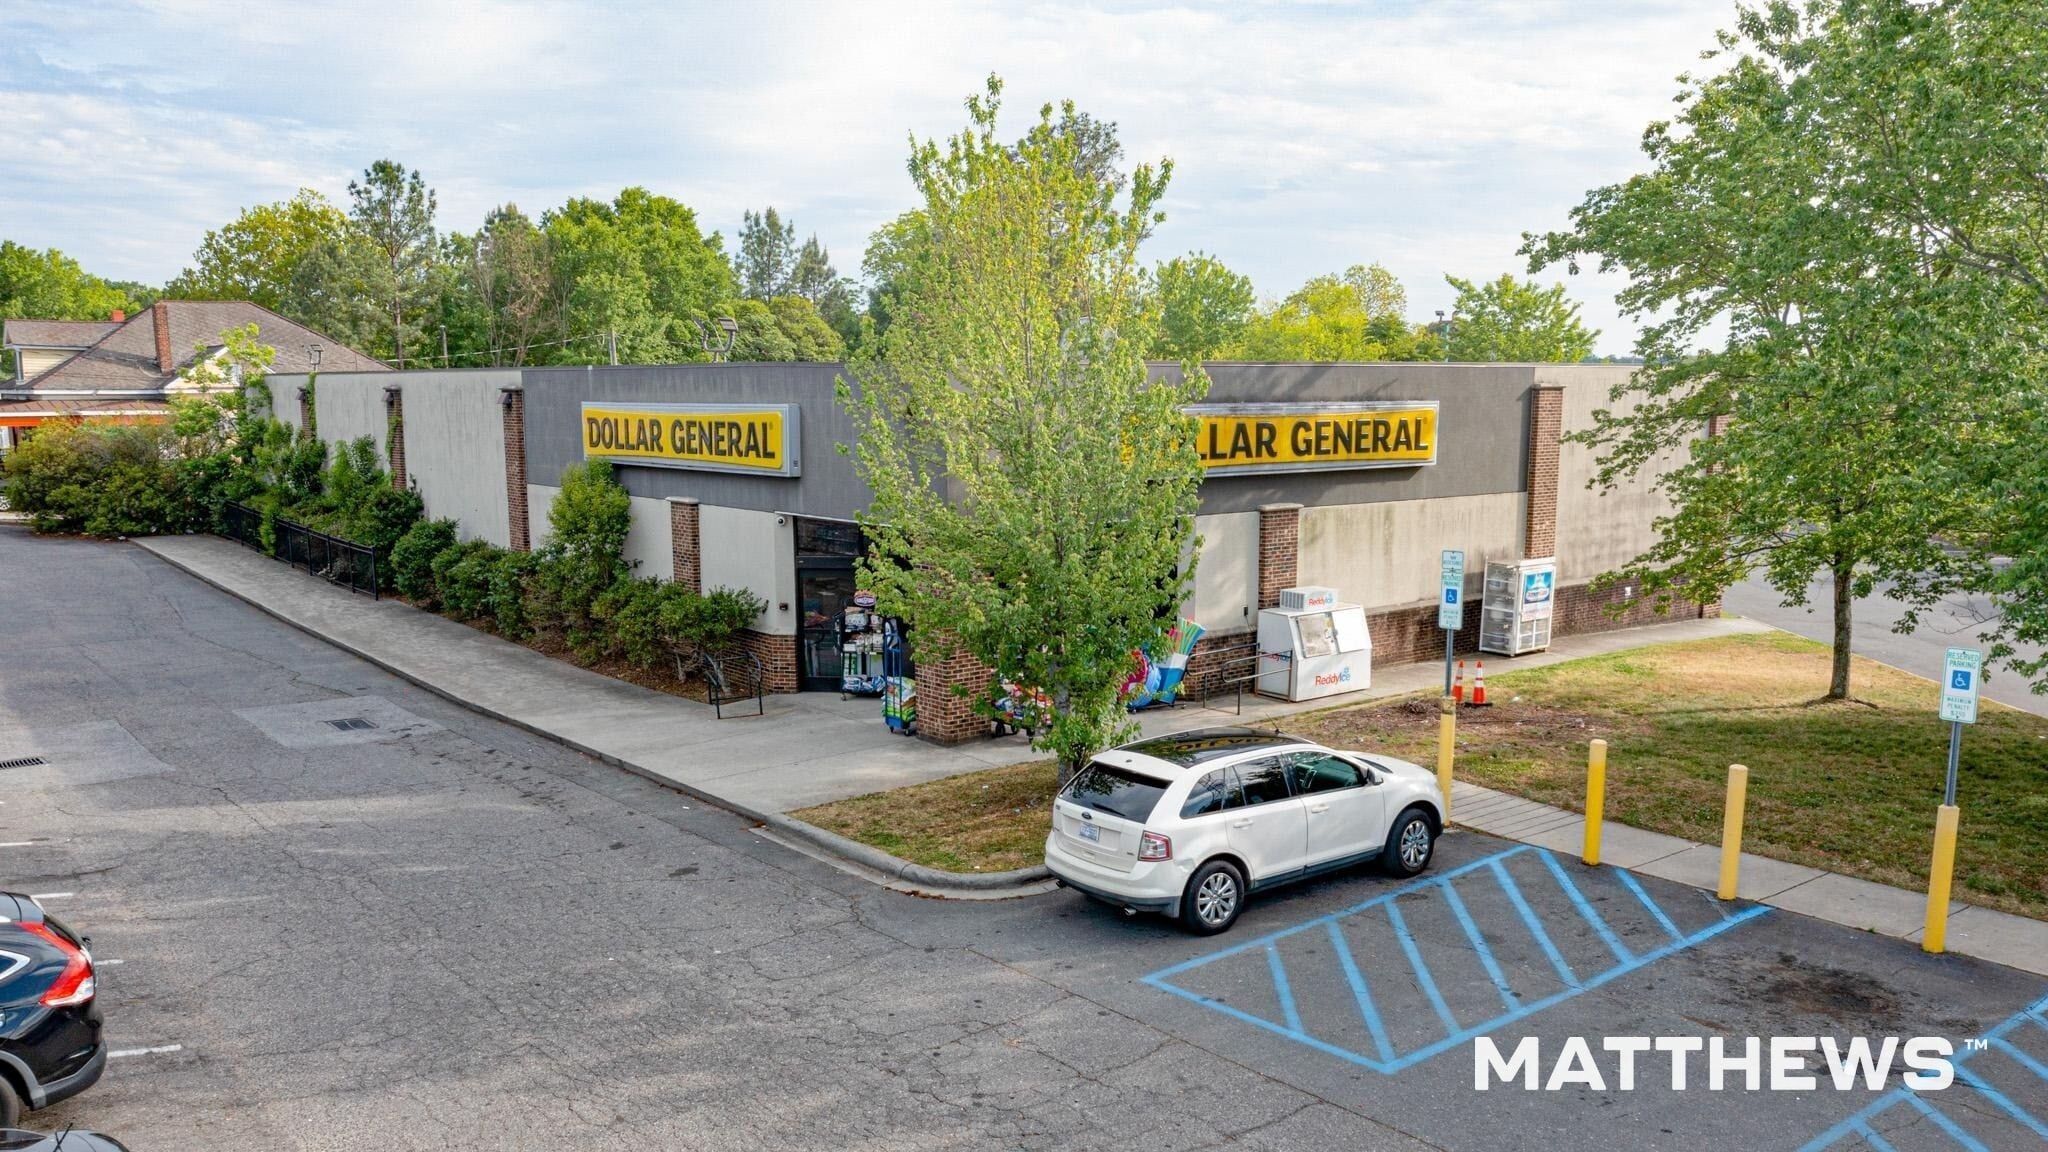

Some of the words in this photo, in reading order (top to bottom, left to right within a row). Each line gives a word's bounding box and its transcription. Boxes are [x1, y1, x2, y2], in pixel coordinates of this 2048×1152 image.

[587, 417, 663, 452] DOLLAR
[671, 419, 775, 459] GENERAL
[1291, 417, 1428, 456] GENERAL
[1950, 660, 1976, 669] PARKING
